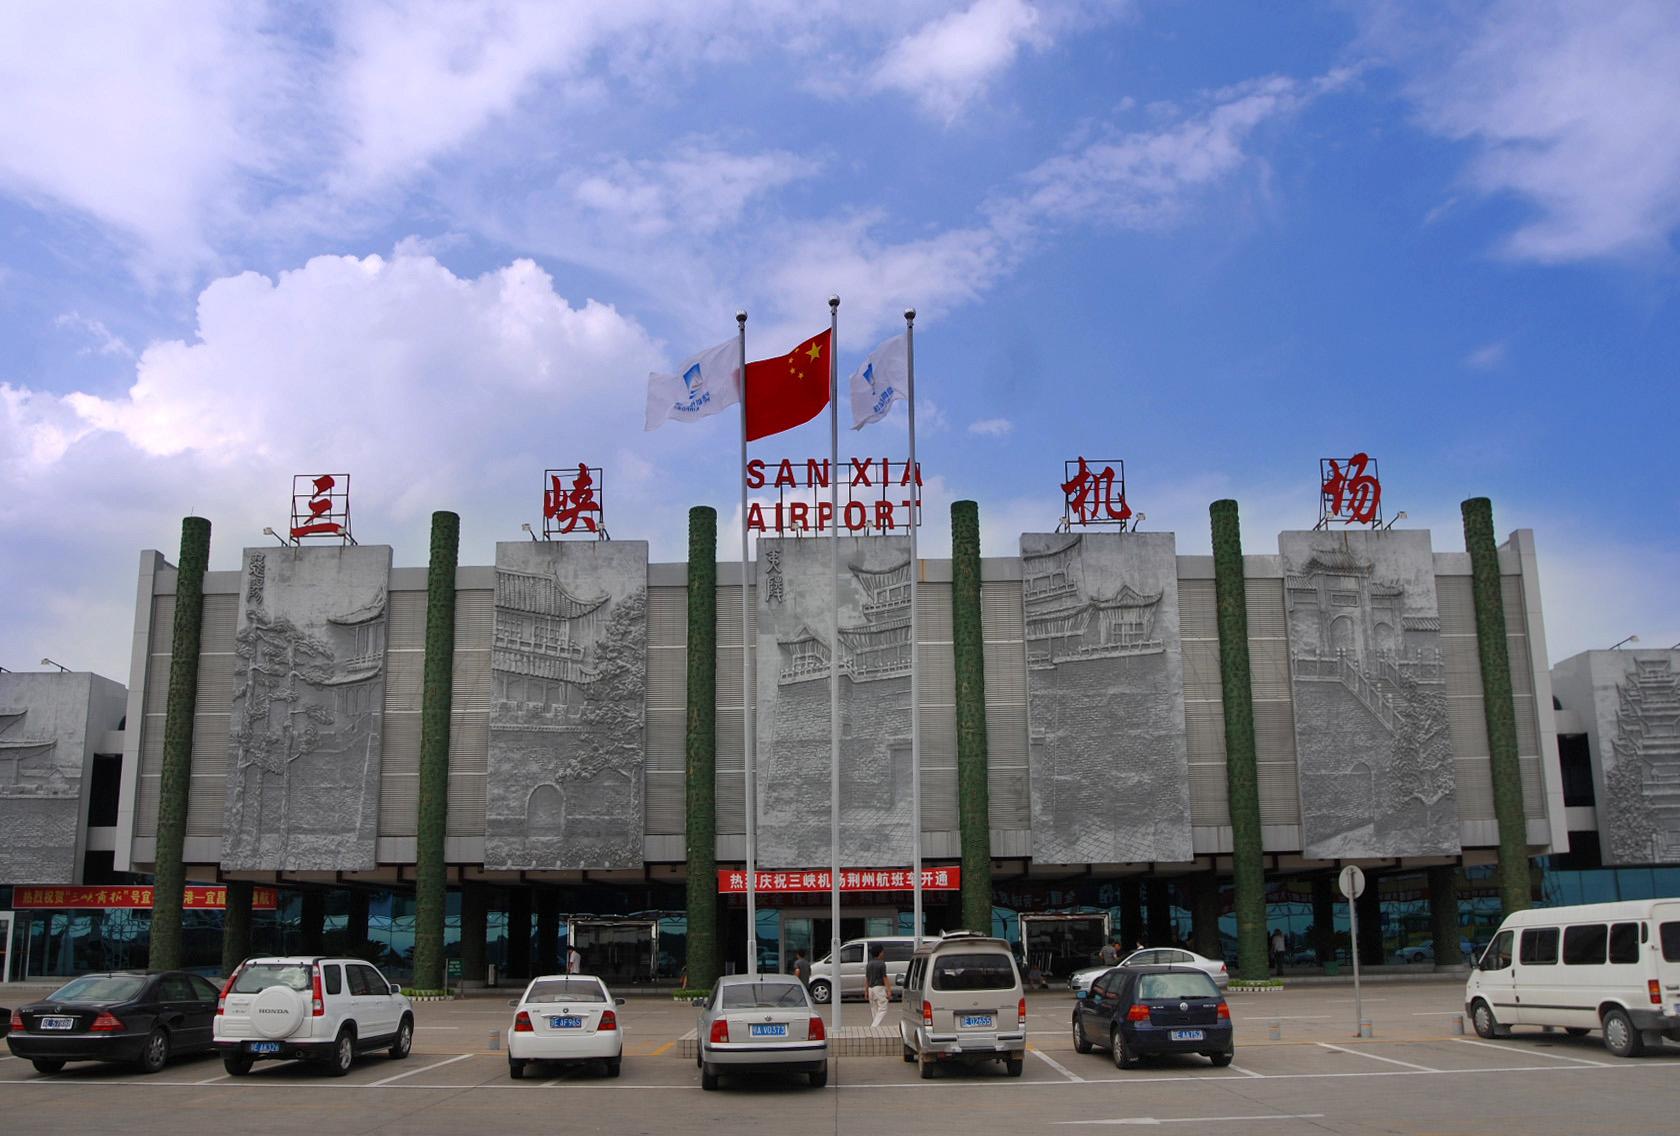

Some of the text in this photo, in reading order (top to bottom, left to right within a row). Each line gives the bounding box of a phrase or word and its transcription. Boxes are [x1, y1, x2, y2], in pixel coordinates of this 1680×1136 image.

[746, 457, 923, 489] SAN XIA
[290, 474, 343, 538] 三
[1061, 455, 1132, 527] 机
[1322, 452, 1382, 525] 场
[746, 500, 922, 532] AIRPORT
